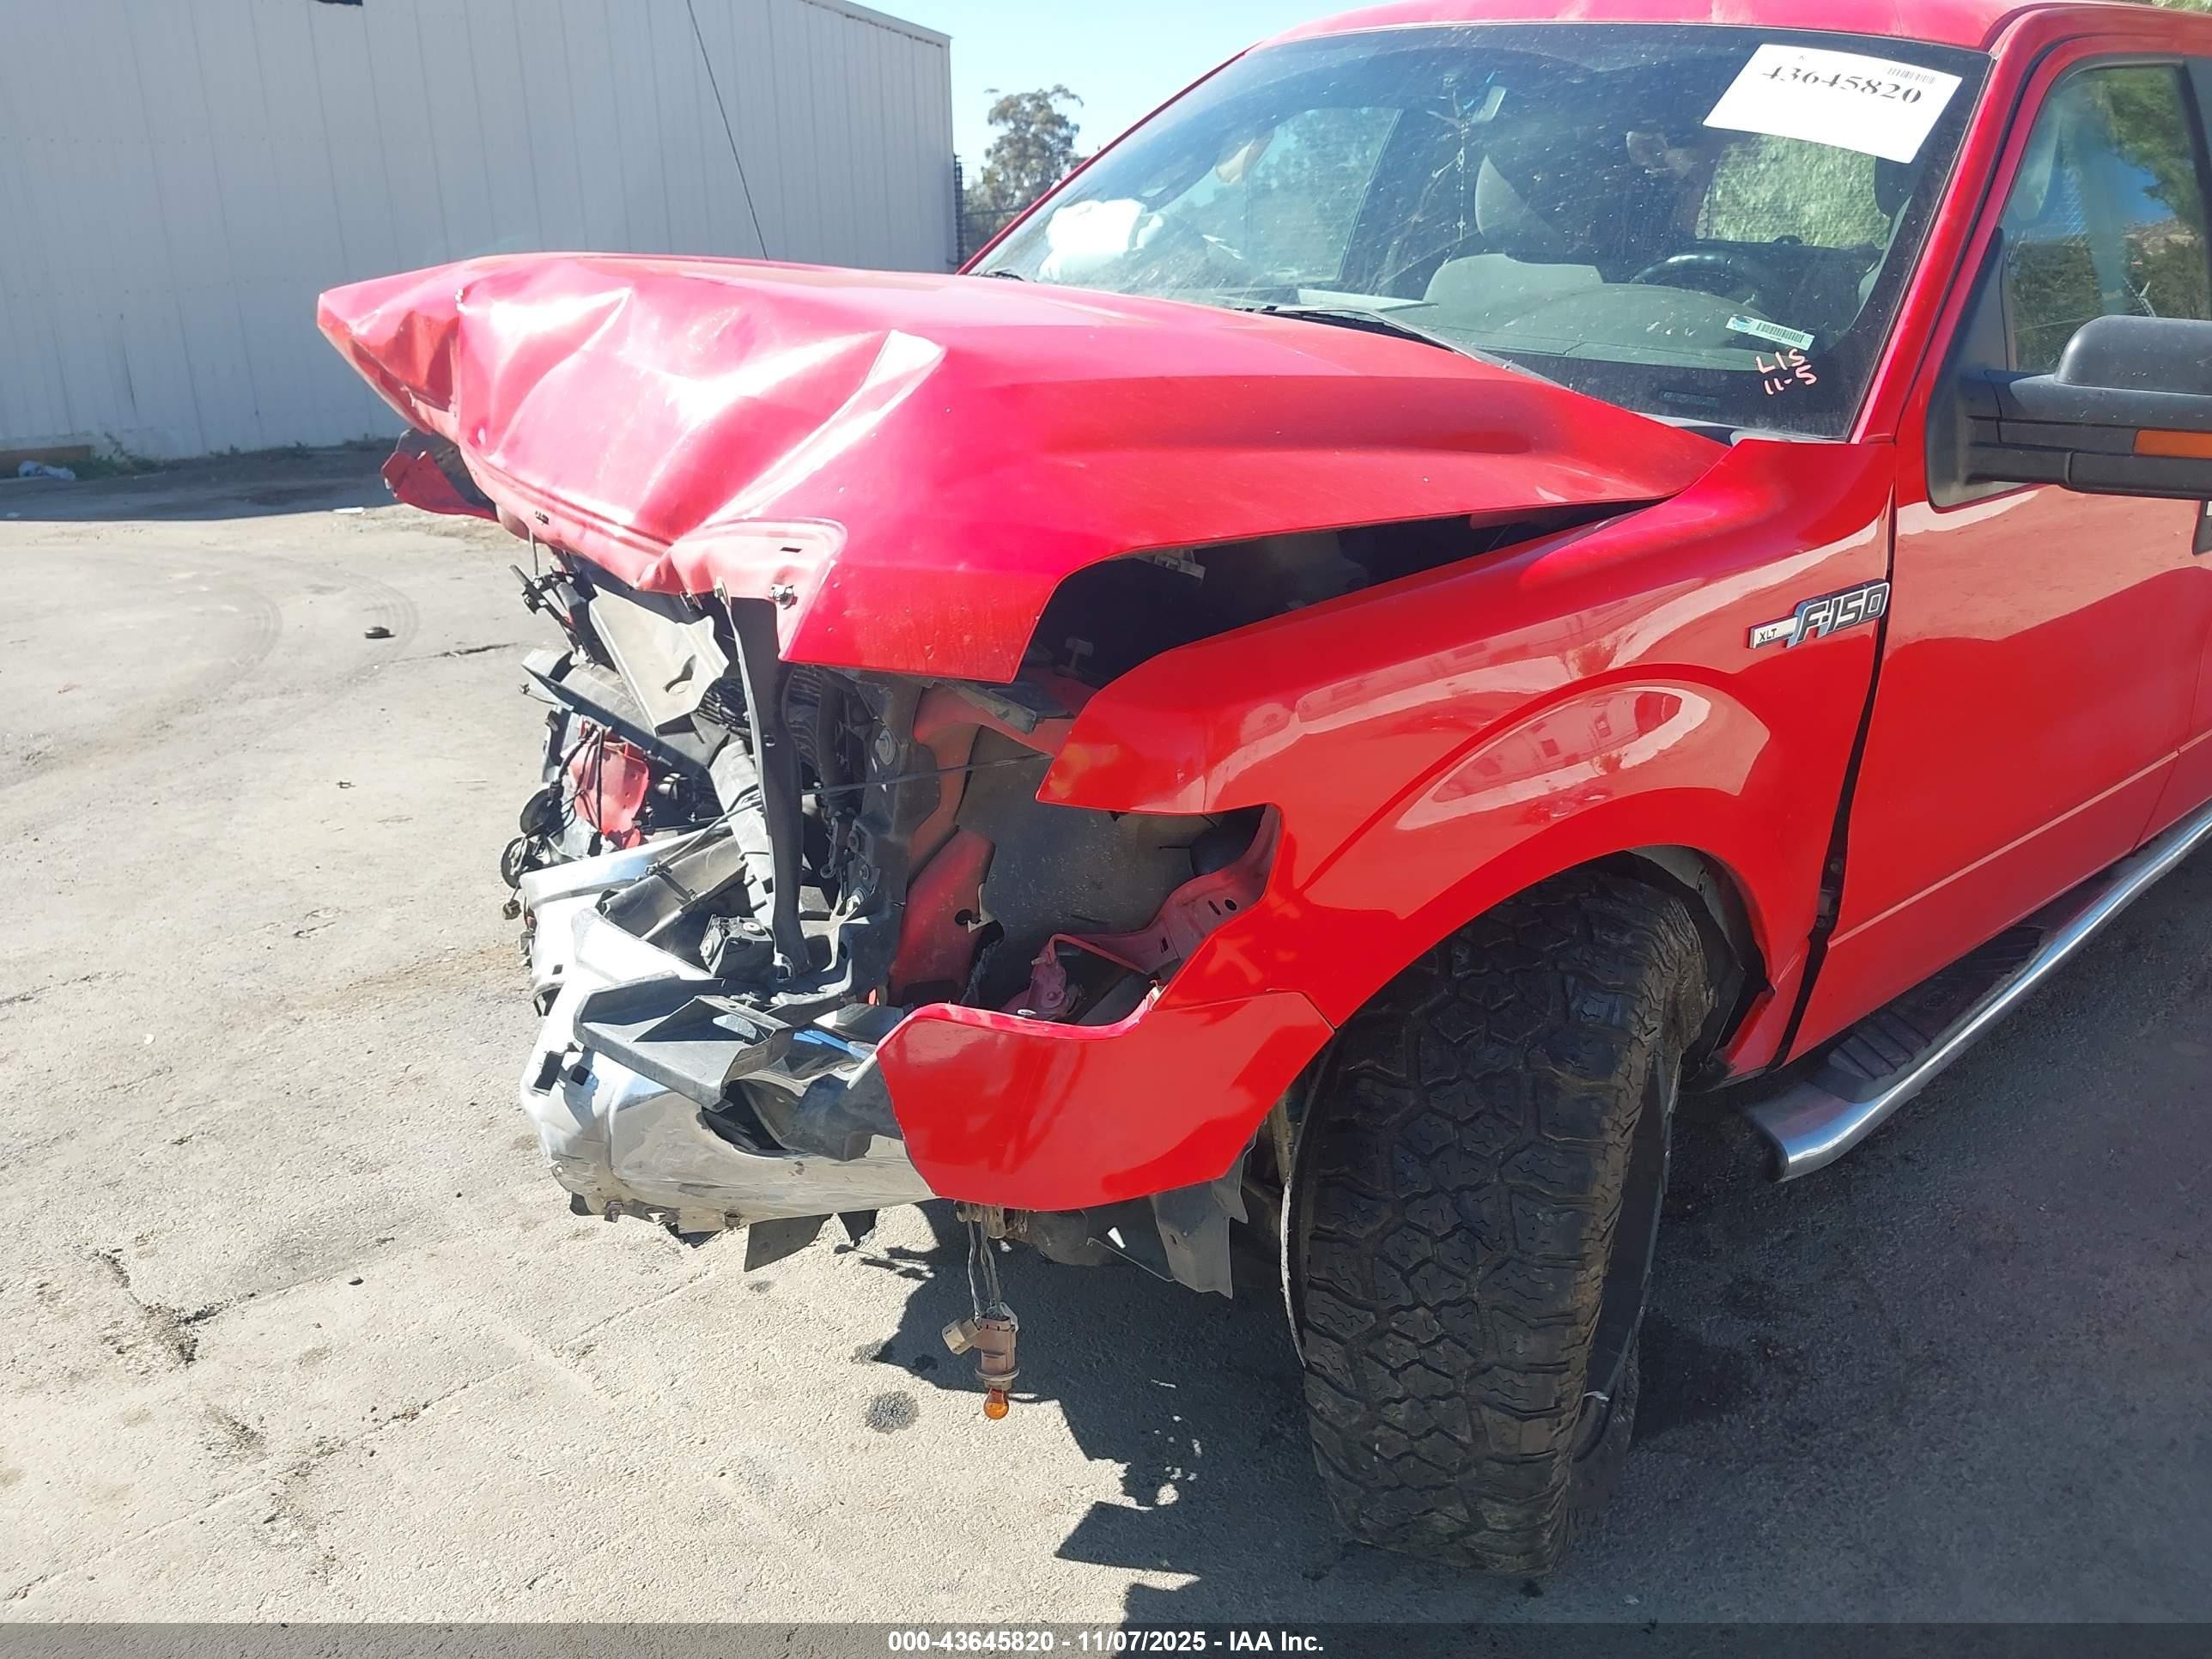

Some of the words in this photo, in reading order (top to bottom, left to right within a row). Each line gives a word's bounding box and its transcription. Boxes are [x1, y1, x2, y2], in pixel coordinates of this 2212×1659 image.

[1763, 66, 1922, 103] 43645820
[1759, 629, 1778, 641] XLT
[1796, 582, 1891, 642] F-150
